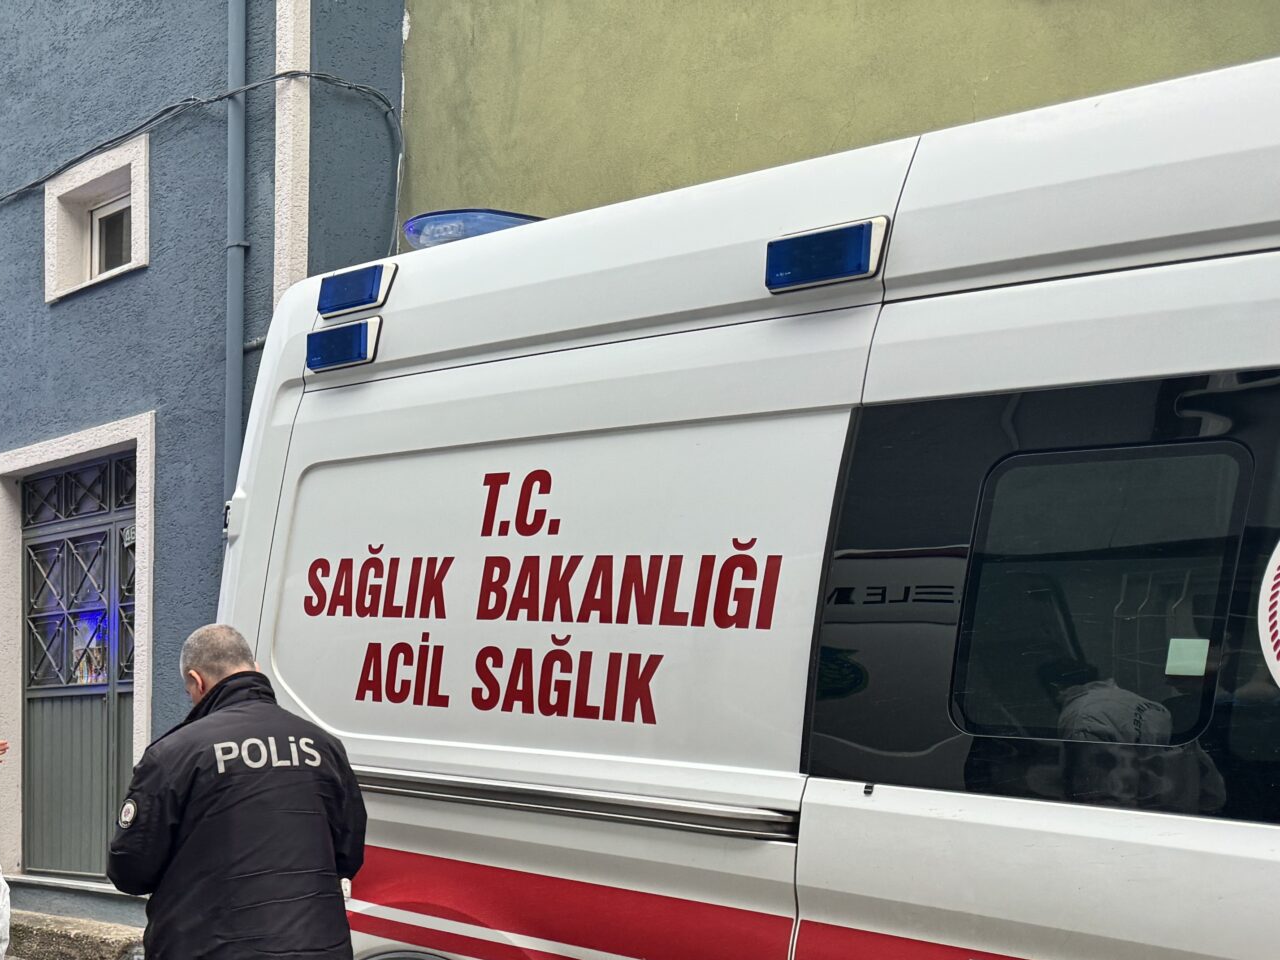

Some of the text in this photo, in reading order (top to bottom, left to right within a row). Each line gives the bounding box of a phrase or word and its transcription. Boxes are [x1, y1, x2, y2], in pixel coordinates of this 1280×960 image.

[481, 469, 561, 537] T.C.
[304, 538, 783, 630] SAĞLIK BAKANLIĞI
[355, 632, 664, 725] ACİL SAĞLIK
[214, 736, 321, 774] POLİS
